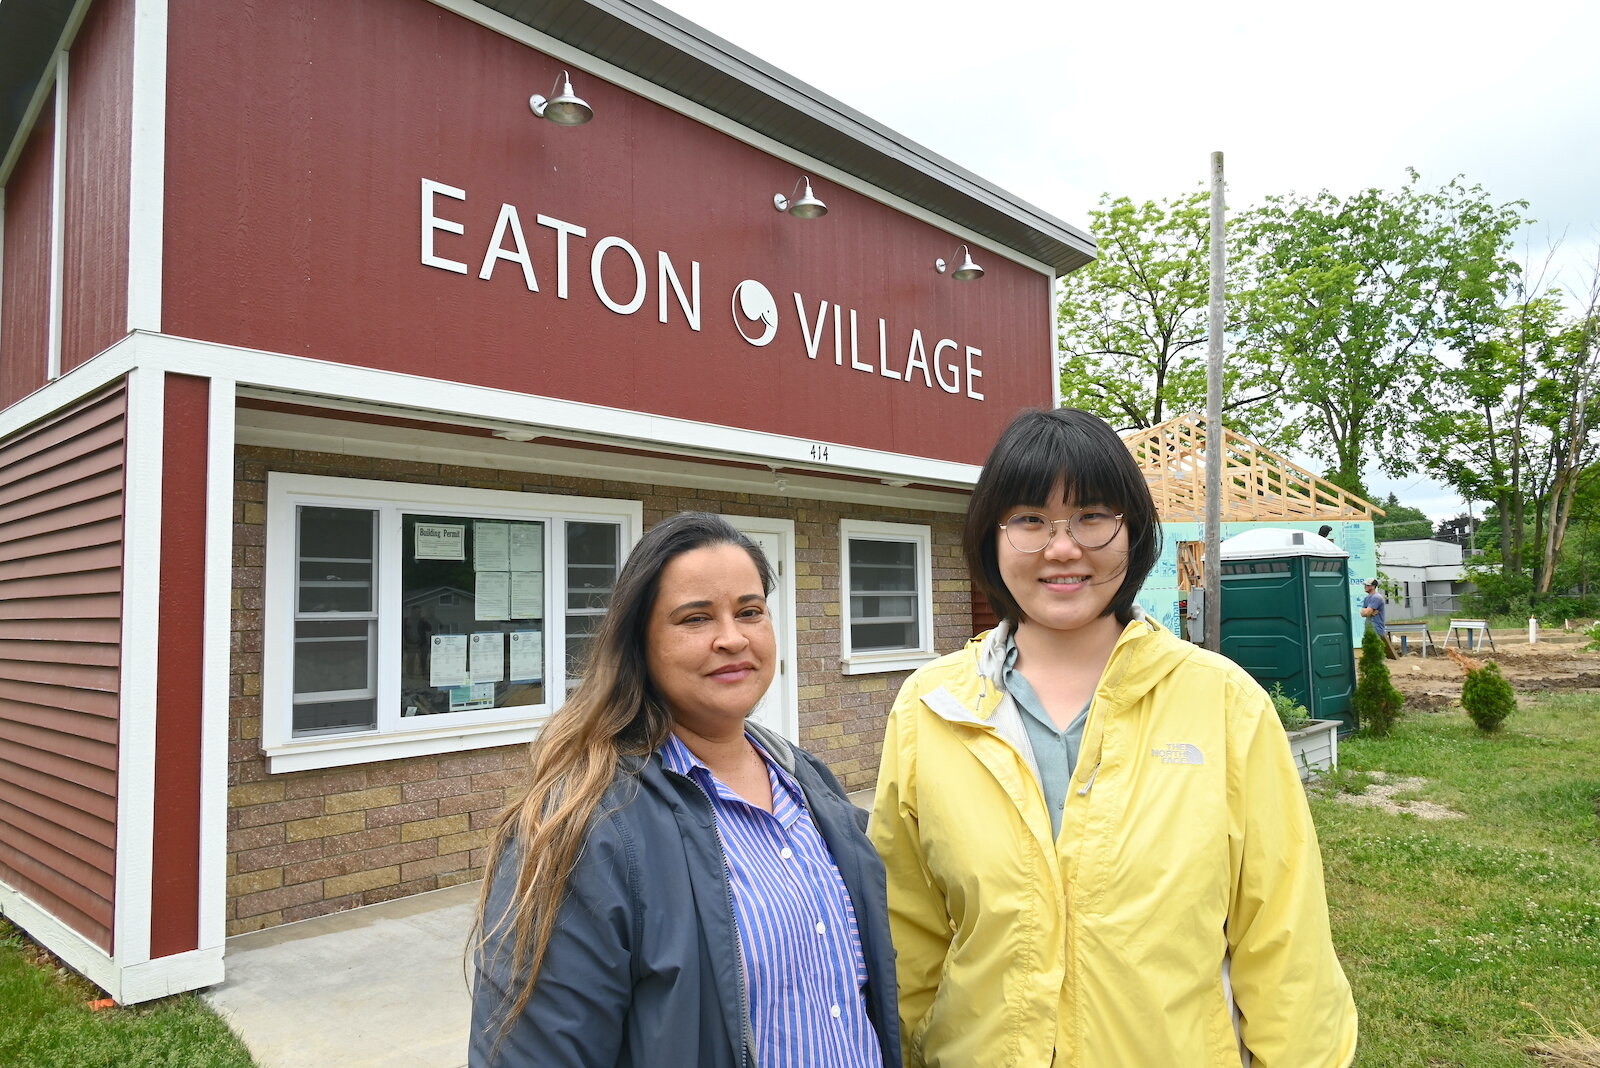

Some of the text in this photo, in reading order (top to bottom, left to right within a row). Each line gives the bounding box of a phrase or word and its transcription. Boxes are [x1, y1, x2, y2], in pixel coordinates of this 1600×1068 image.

[420, 177, 985, 402] EATON VILLAGE
[810, 444, 829, 462] 414
[419, 528, 461, 539] Building Permit
[1151, 749, 1188, 757] NORTH
